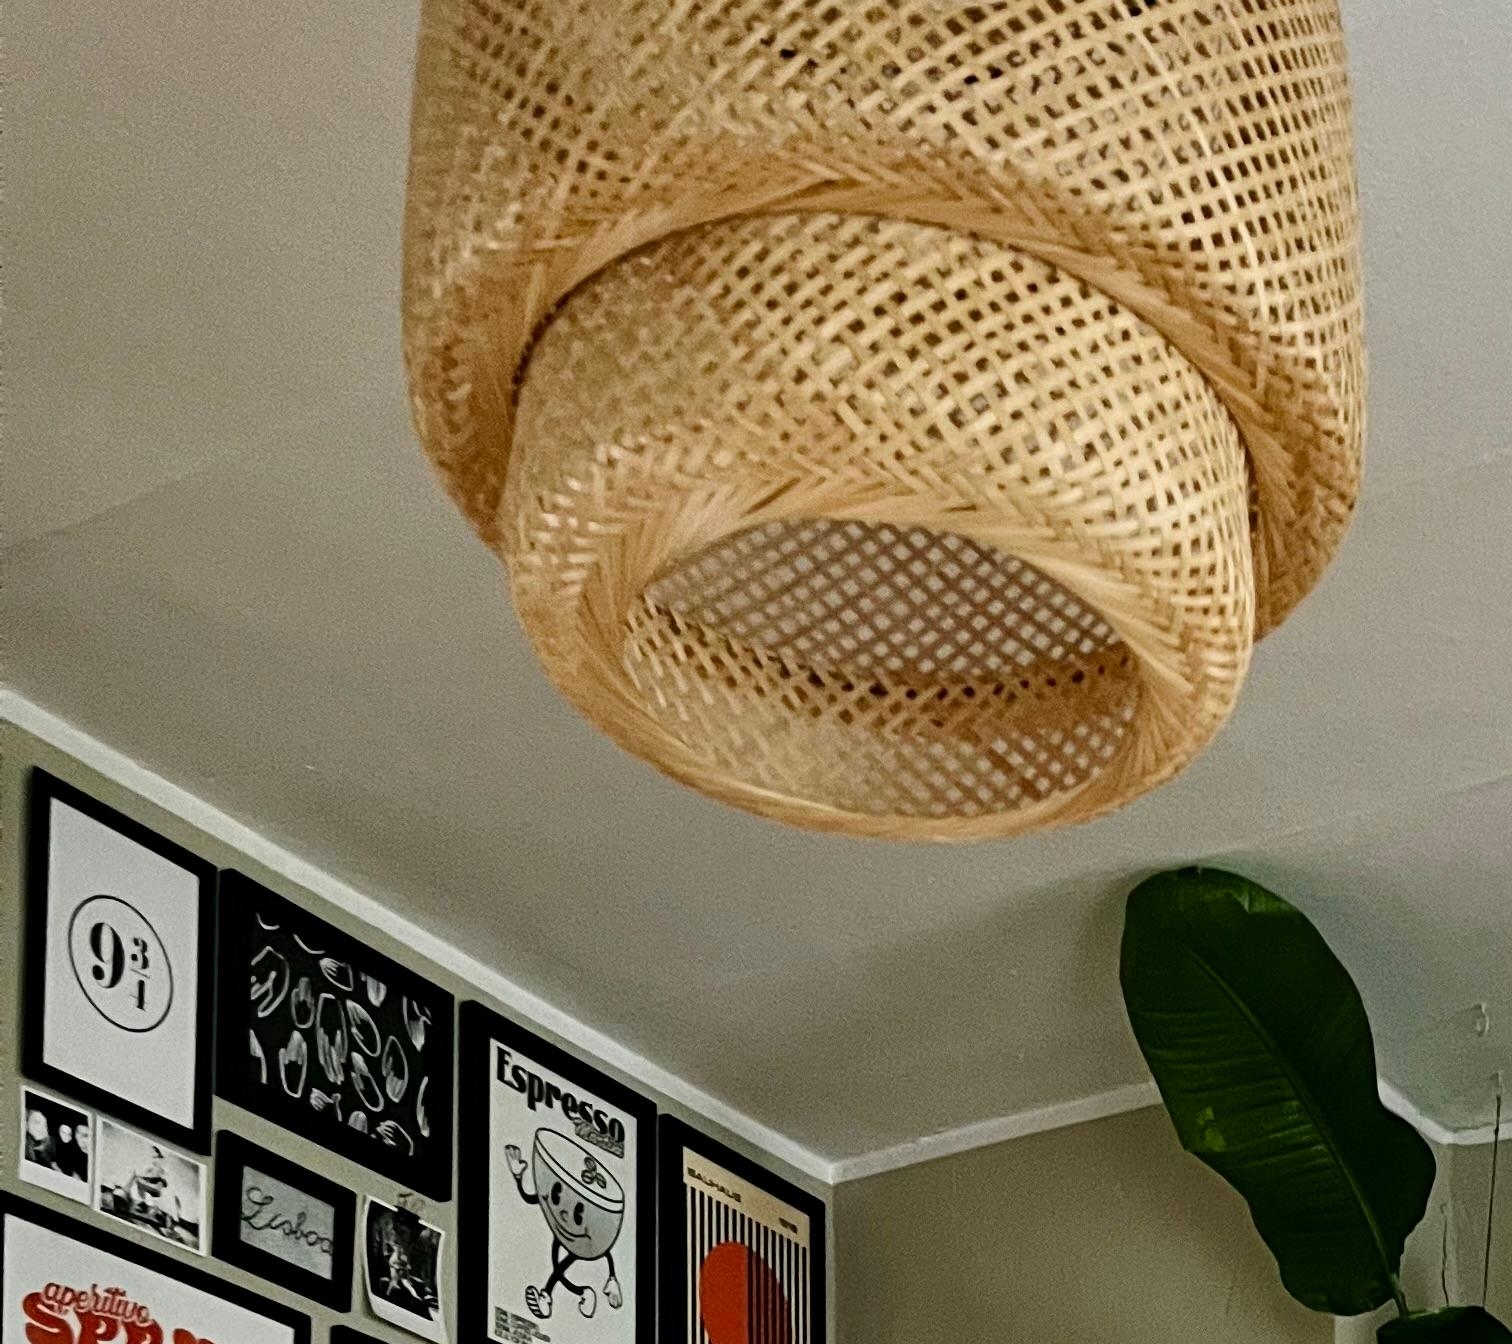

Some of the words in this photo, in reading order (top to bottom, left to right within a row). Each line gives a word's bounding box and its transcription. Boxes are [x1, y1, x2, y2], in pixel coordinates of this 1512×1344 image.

[496, 1045, 625, 1143] Espresso
[240, 1187, 333, 1256] Lisboa
[43, 1282, 151, 1325] aperitivo
